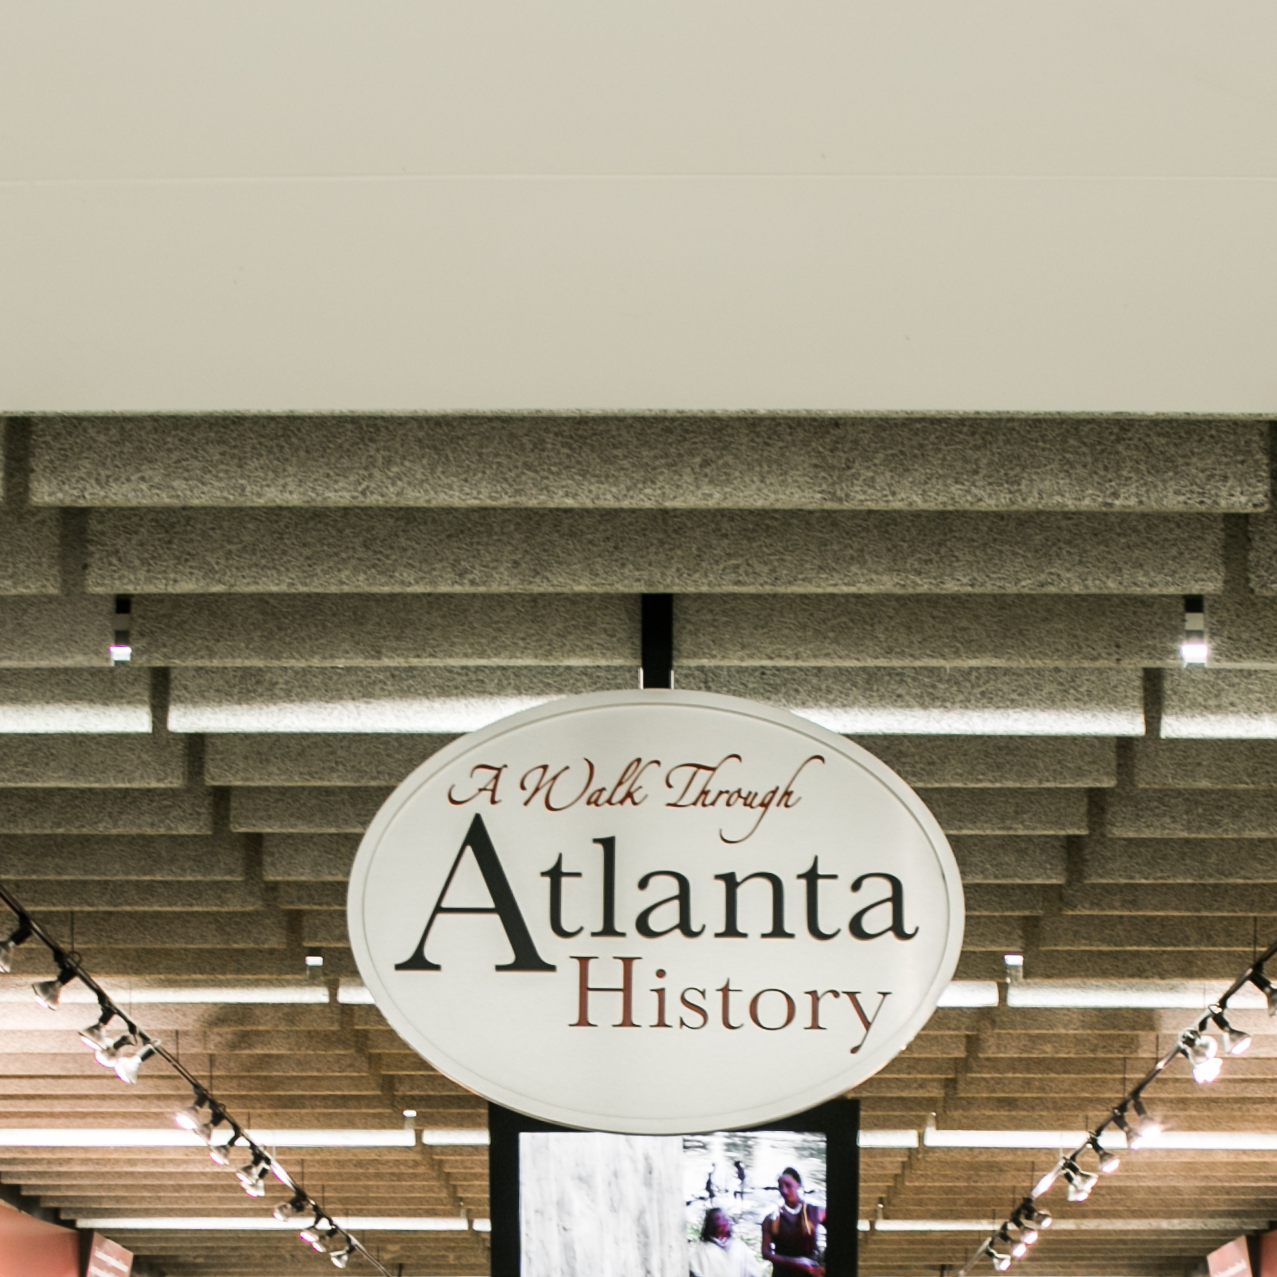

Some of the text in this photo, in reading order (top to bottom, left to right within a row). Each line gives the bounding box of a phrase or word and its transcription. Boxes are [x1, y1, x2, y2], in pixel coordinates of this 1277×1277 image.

[447, 754, 826, 844] A Walk Through
[394, 812, 920, 973] Atlanta
[568, 955, 892, 1054] History
